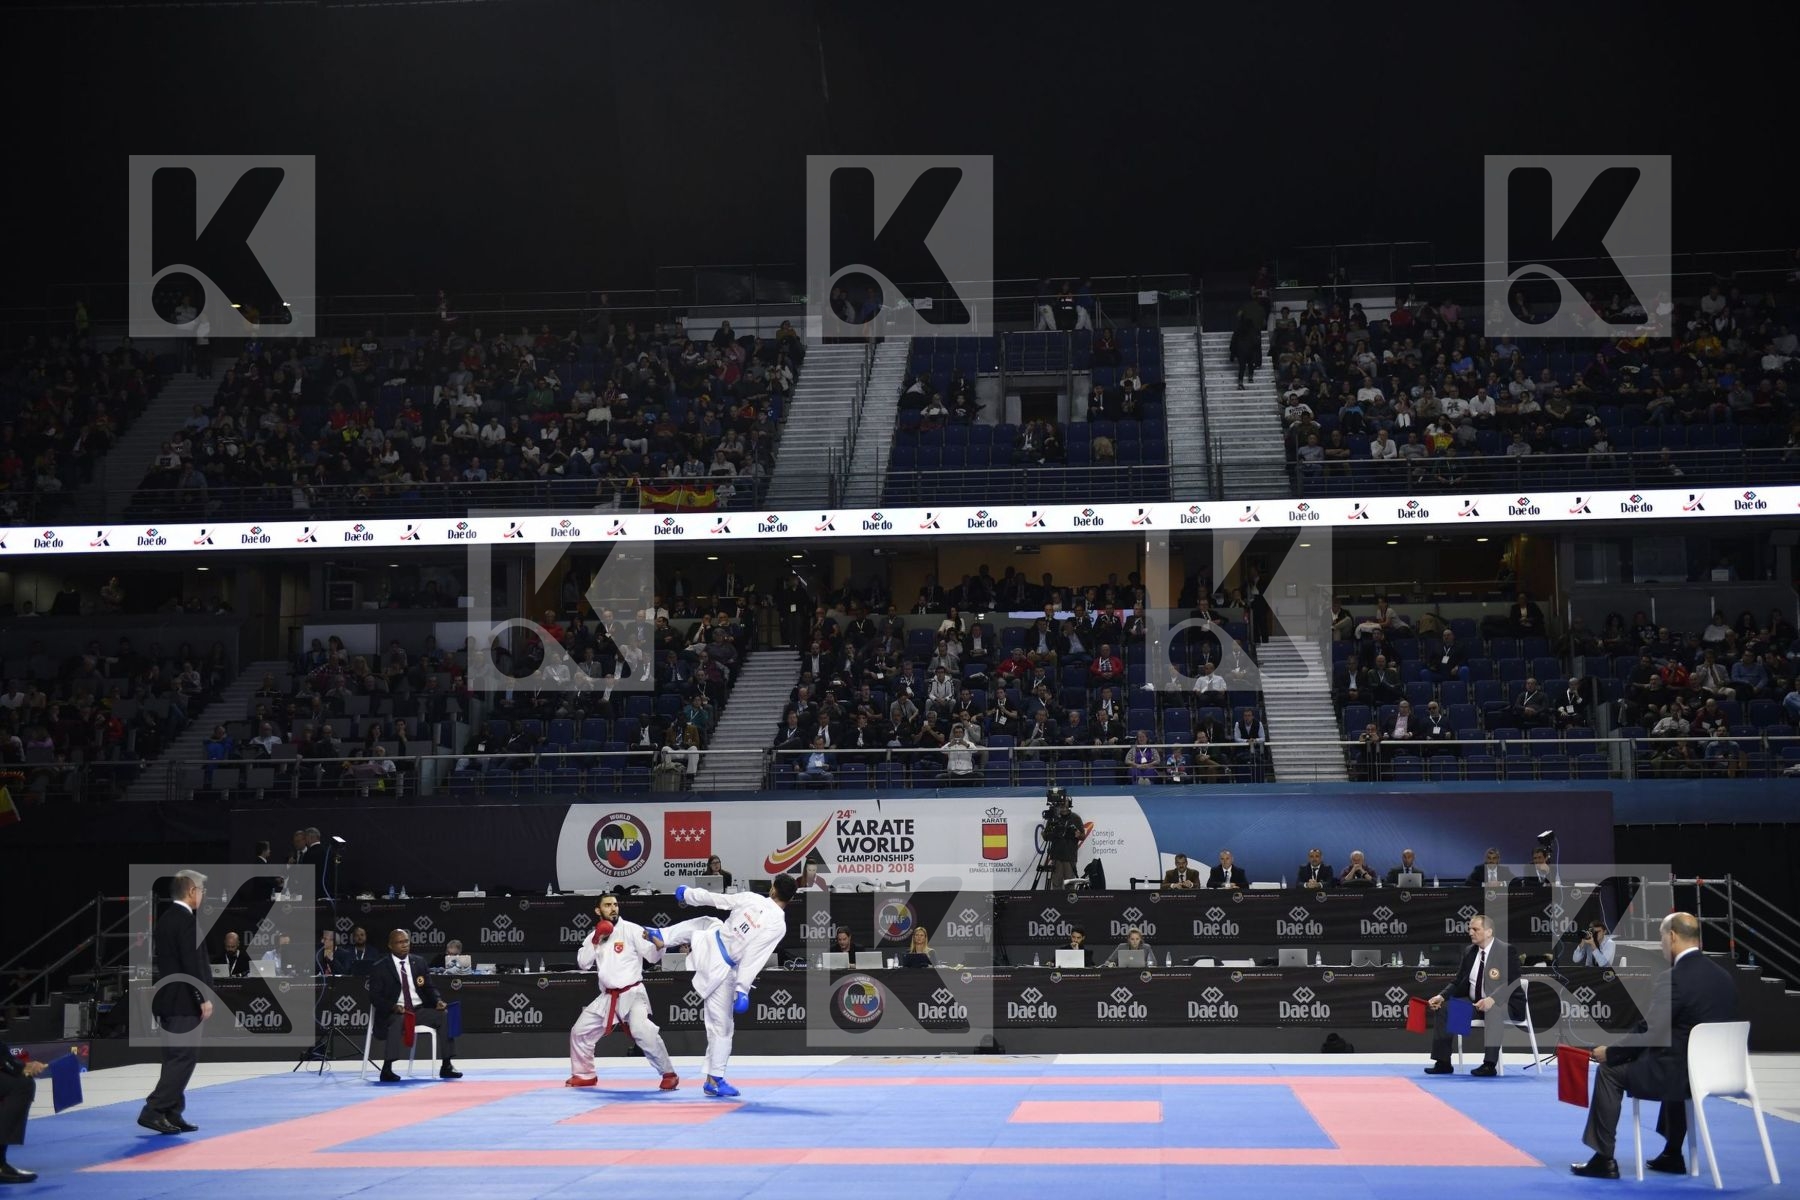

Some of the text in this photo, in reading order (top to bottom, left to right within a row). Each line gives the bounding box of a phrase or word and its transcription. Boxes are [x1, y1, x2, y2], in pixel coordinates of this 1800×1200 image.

[610, 813, 631, 821] WORLD
[836, 819, 914, 836] KARATE
[1092, 830, 1115, 838] Consejo
[604, 839, 634, 851] WKF
[837, 837, 914, 853] WORLD
[1092, 847, 1118, 855] Deportes
[836, 854, 914, 863] CHAMPIONSHIPS
[664, 861, 707, 869] Comunida
[837, 863, 914, 874] MADRID 2018
[664, 869, 706, 877] de Madri
[884, 915, 905, 924] WKF
[800, 923, 841, 939] Daed
[850, 995, 873, 1004] WKF
[669, 1005, 705, 1022] Dae
[1007, 1001, 1057, 1019] Daedo
[1097, 1001, 1148, 1018] Daedo
[1188, 1001, 1238, 1018] Daedo
[1279, 1000, 1330, 1018] Daedo
[1371, 1001, 1408, 1018] Dae
